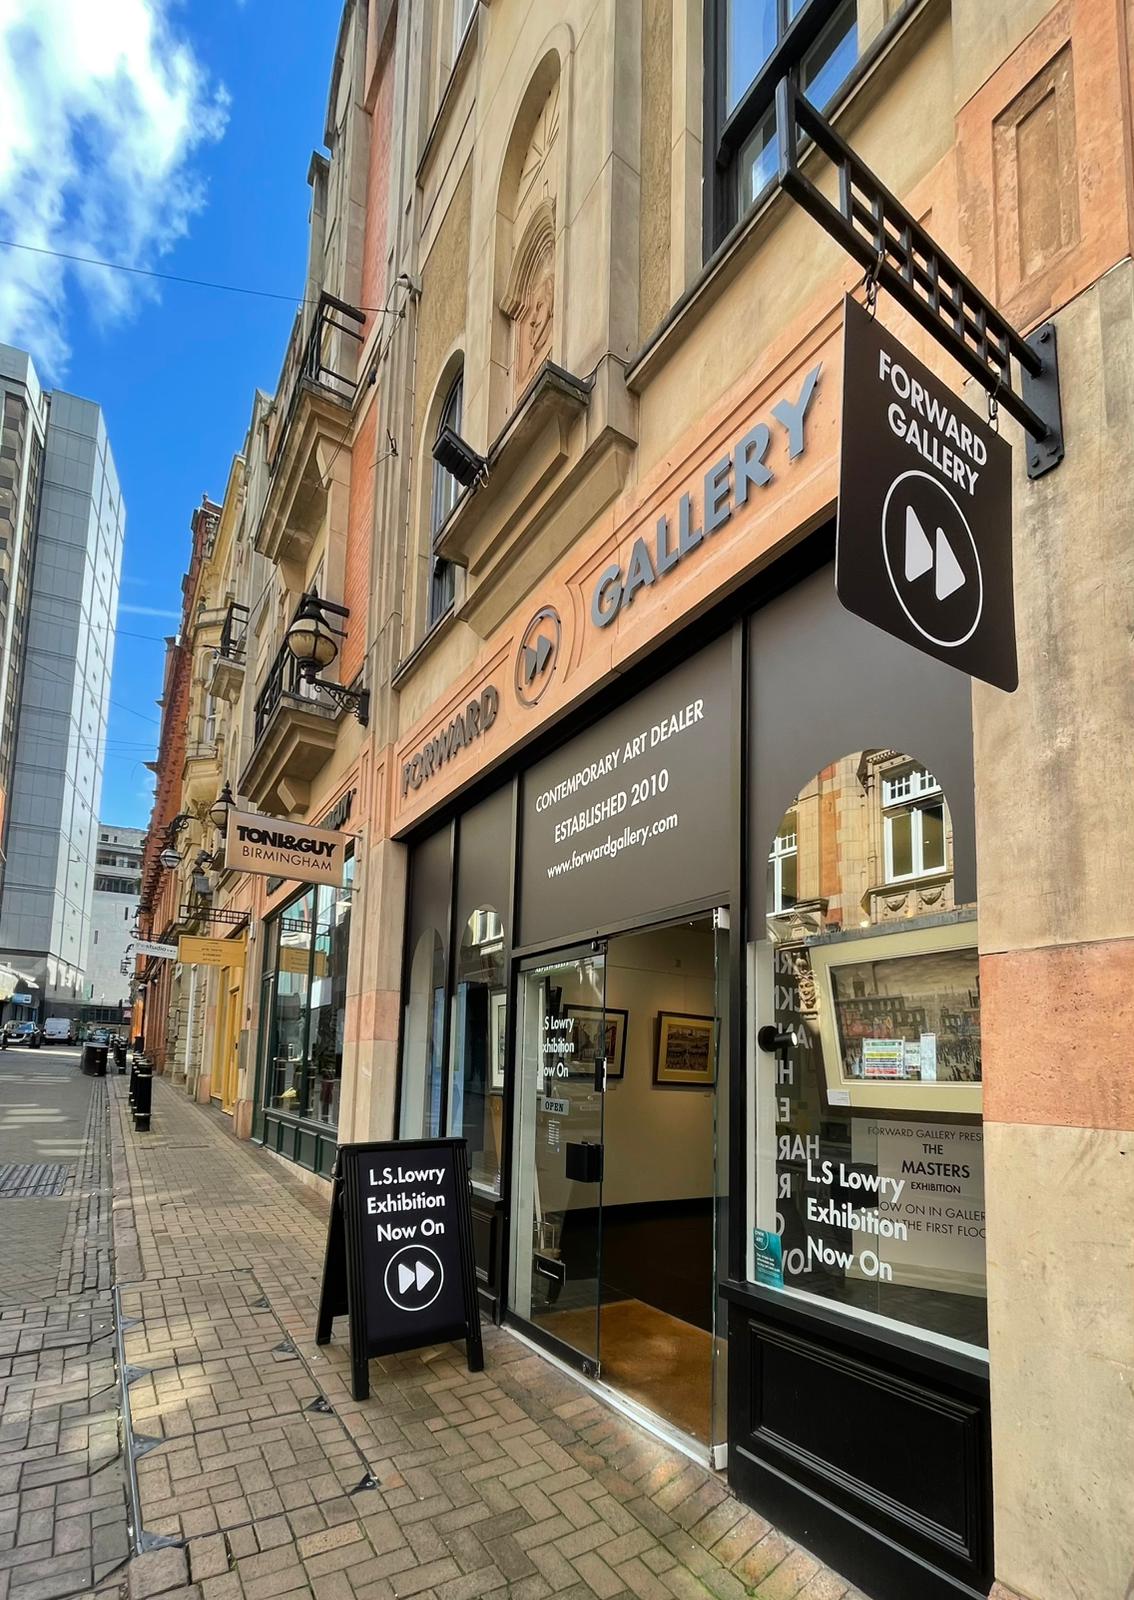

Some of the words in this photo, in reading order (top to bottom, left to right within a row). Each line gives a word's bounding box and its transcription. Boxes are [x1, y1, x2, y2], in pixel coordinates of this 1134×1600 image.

[879, 349, 988, 467] FORWARD
[888, 403, 979, 497] GALLERY
[402, 685, 498, 799] FORWARD
[591, 361, 823, 629] GALLERY
[535, 748, 621, 813] CONTEMPORARY
[622, 732, 647, 763] ART
[650, 699, 704, 748] DEALER
[554, 791, 628, 843] ESTABLISHED
[631, 768, 669, 806] 2010
[236, 825, 337, 857] TONI&GUY
[547, 812, 678, 879] www.forwardgallery.com
[242, 846, 332, 871] BIRMINGHAM
[551, 1015, 574, 1033] Lowry
[543, 1037, 574, 1053] xhibition
[543, 1066, 555, 1077] ow
[556, 1062, 569, 1077] On
[545, 1101, 564, 1113] OPEN
[868, 1127, 914, 1137] FORWARD
[916, 1130, 955, 1141] GALLERY
[959, 1131, 983, 1142] PRES
[922, 1144, 944, 1155] THE
[369, 1166, 446, 1186] L.S.Lowry
[807, 1159, 833, 1184] L.S
[840, 1164, 905, 1203] Lowry
[901, 1160, 970, 1178] MASTERS
[911, 1181, 961, 1193] EXHIBITION
[367, 1191, 445, 1215] Exhibition
[905, 1203, 925, 1215] ON
[929, 1206, 942, 1217] IN
[377, 1224, 417, 1243] Now
[420, 1219, 445, 1238] On
[807, 1197, 908, 1241] Exhibition
[926, 1222, 954, 1234] FIRST
[807, 1235, 853, 1270] Now
[859, 1250, 893, 1281] On
